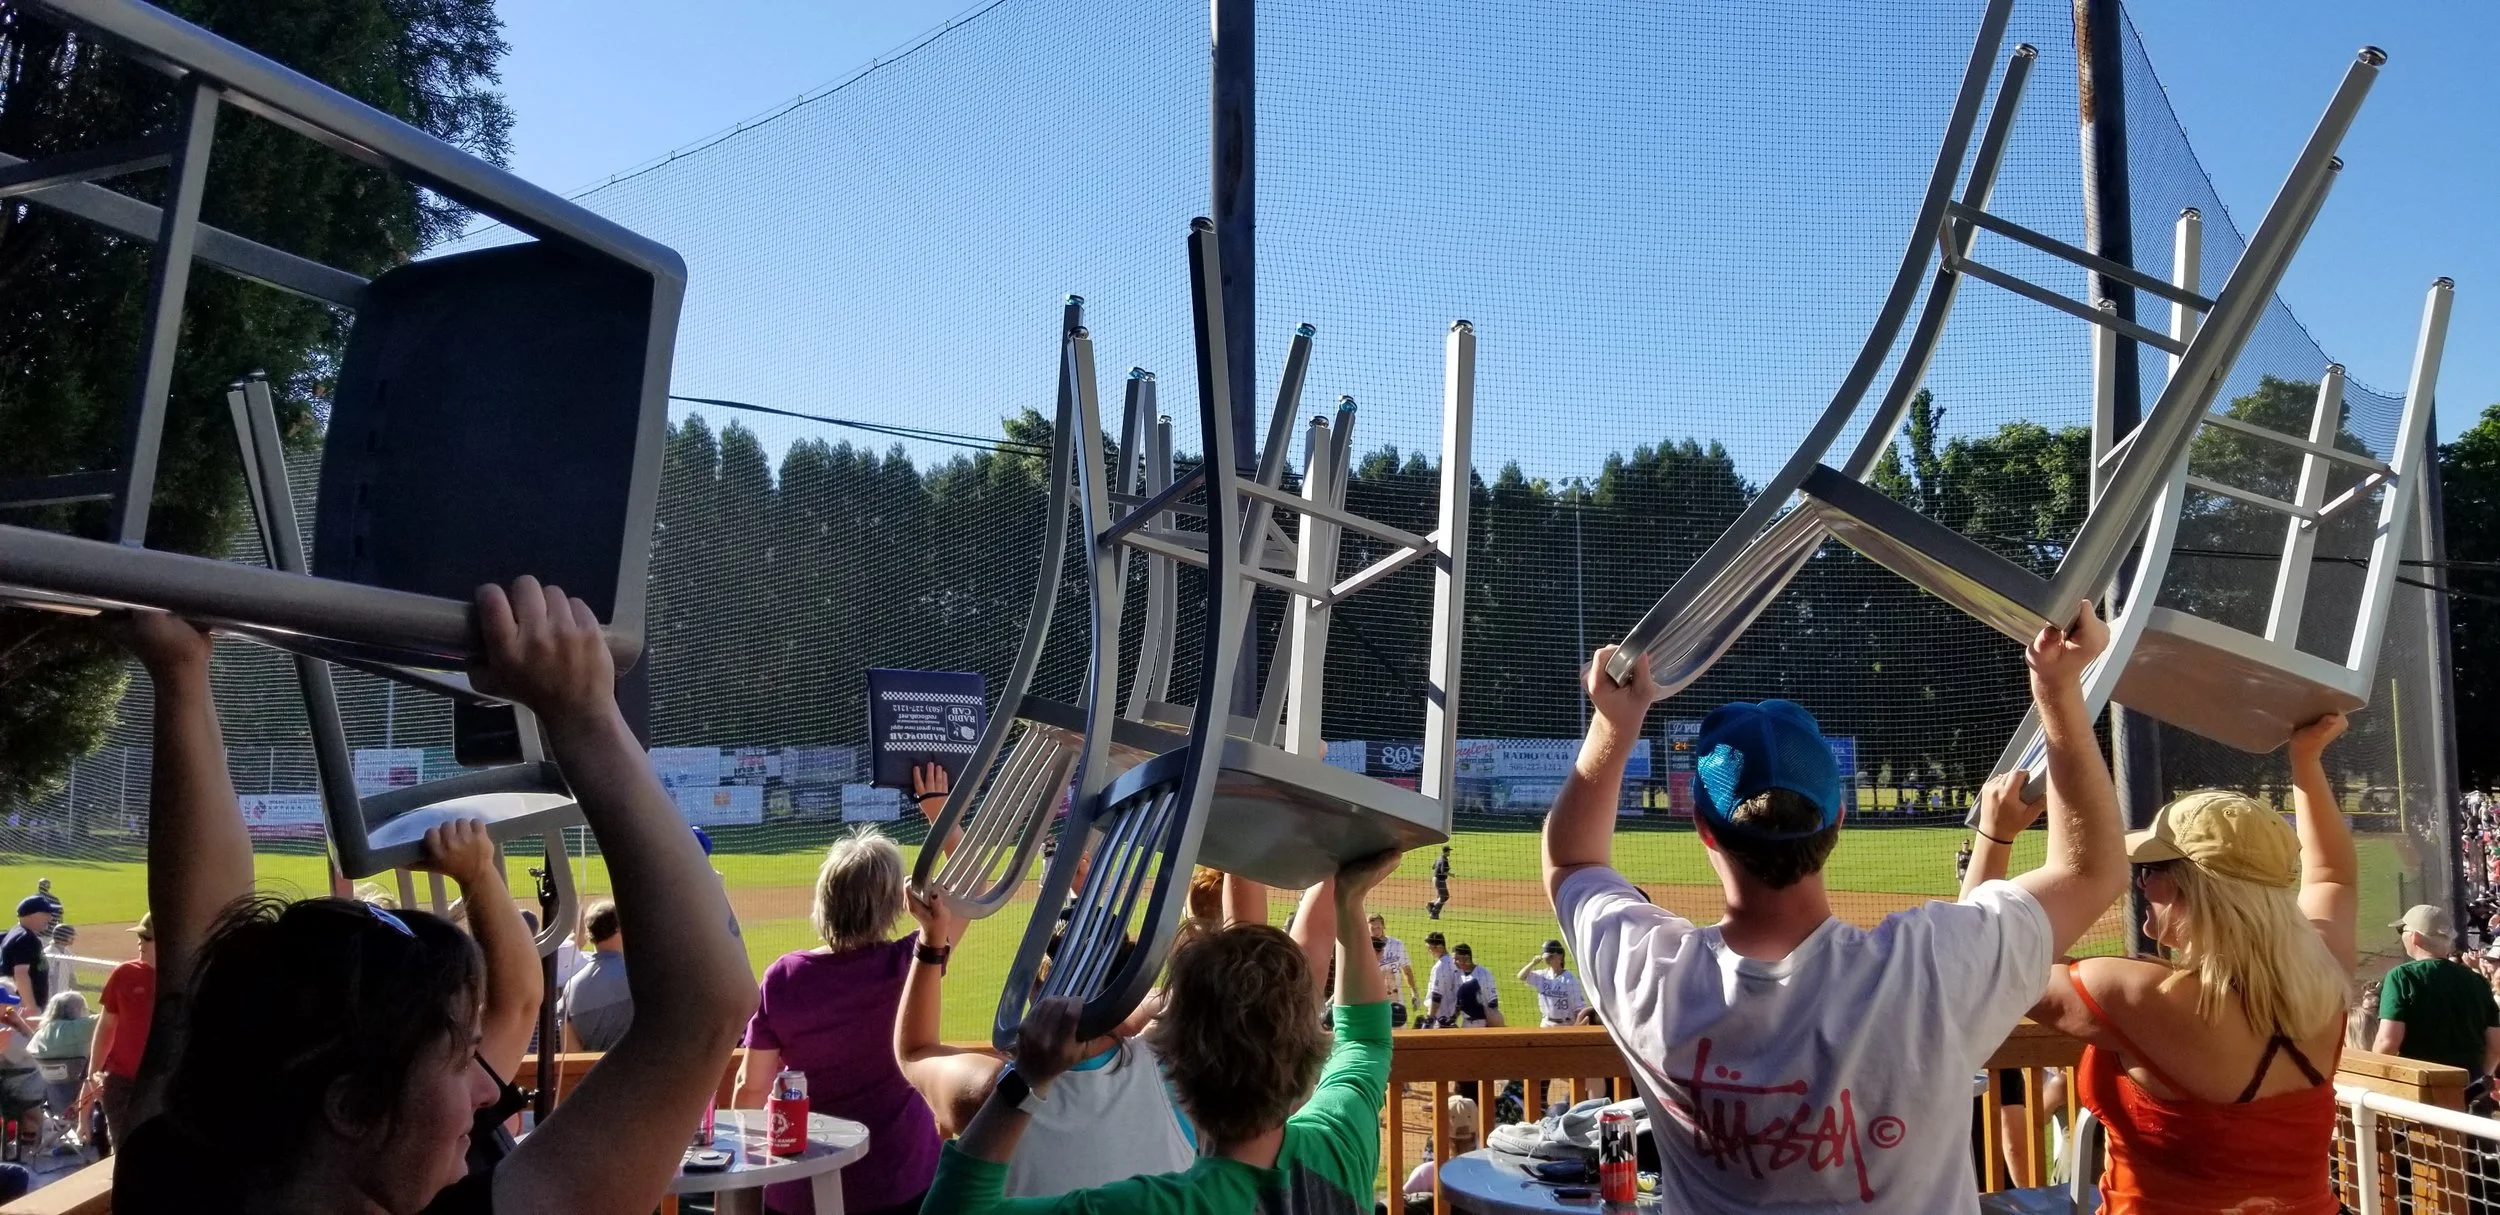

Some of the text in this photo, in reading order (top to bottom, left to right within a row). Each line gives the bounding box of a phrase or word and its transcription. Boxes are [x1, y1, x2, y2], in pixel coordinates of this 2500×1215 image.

[892, 704, 943, 713] (503) 227-1212
[952, 707, 971, 715] CAB
[948, 714, 975, 723] RADIO
[890, 732, 946, 741] RADIO CAB
[1382, 744, 1424, 764] 805
[1503, 752, 1568, 760] RADIO CAB
[1554, 998, 1568, 1010] 49
